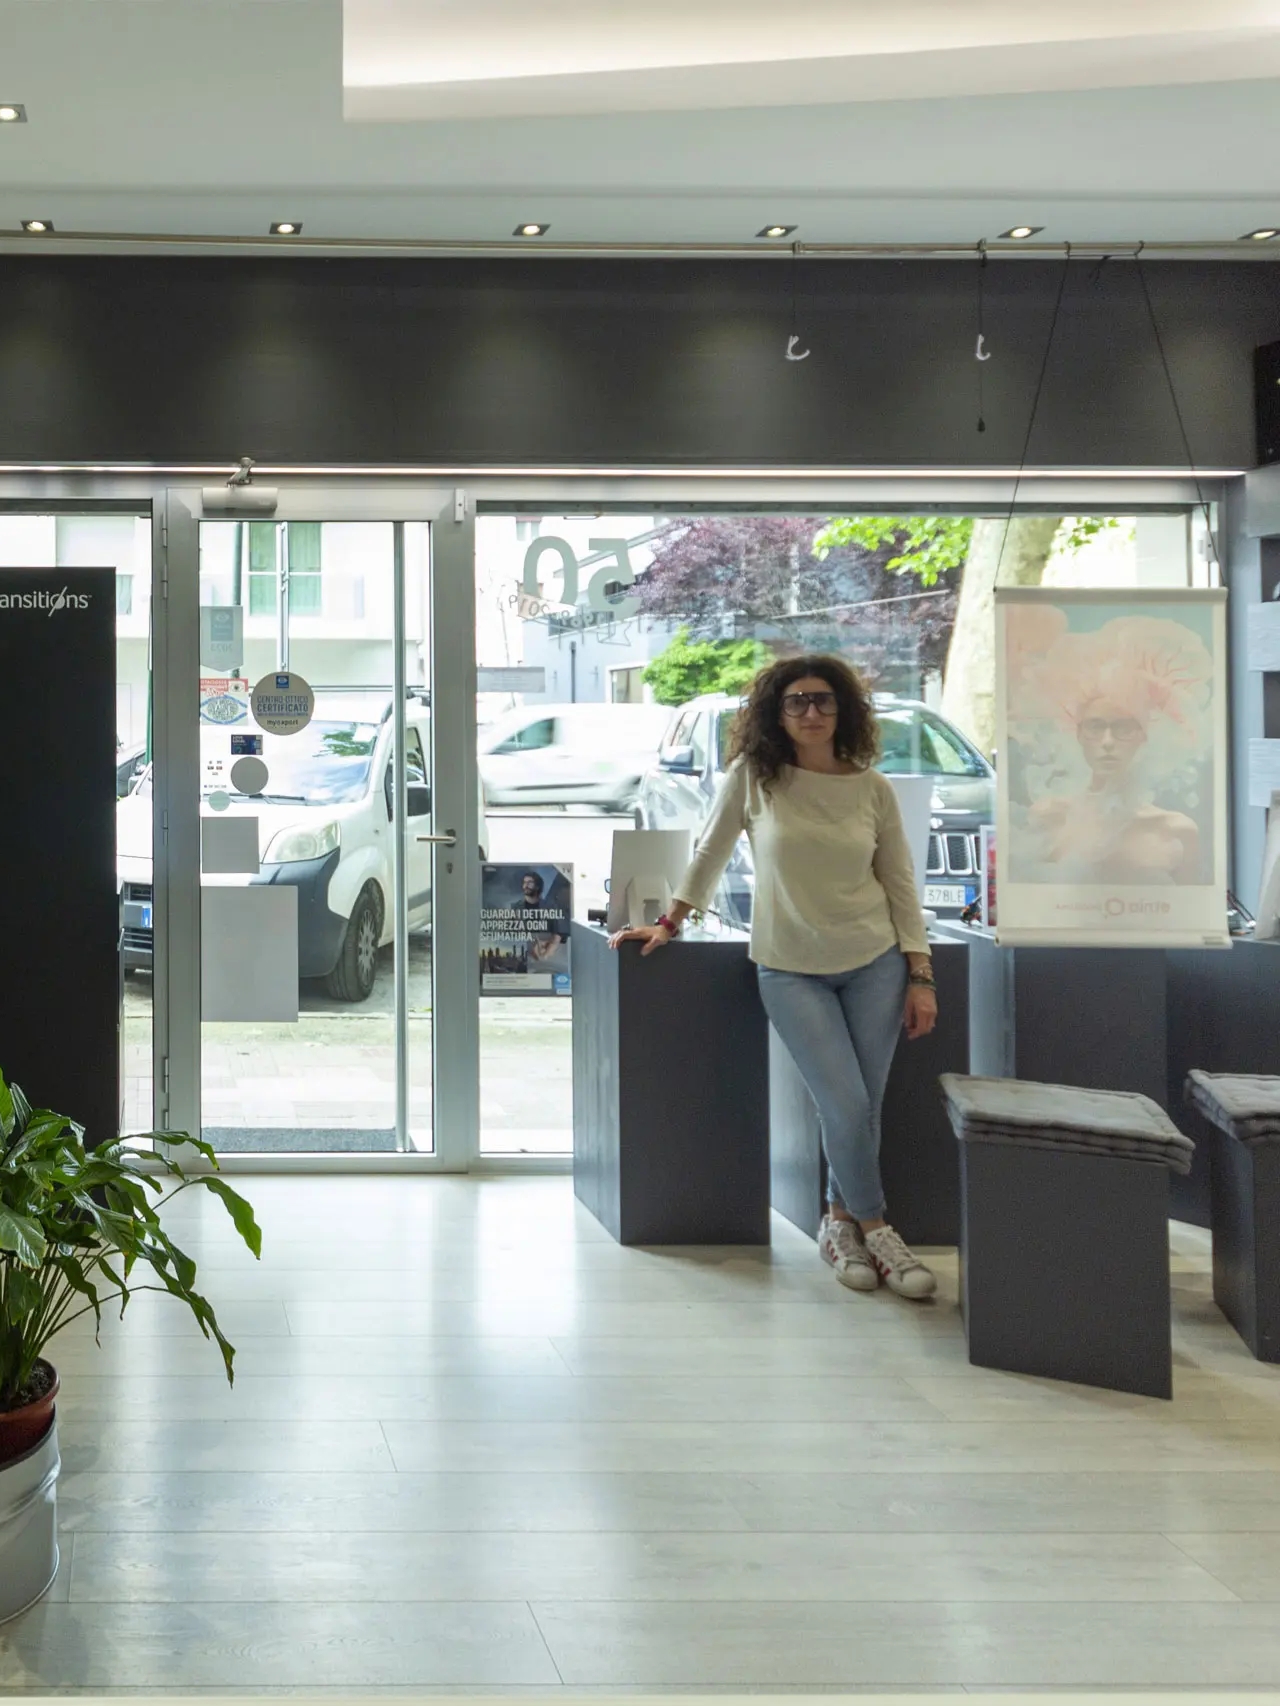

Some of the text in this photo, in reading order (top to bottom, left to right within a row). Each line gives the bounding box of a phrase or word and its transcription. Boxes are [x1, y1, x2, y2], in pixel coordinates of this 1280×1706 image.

[257, 703, 309, 713] CERTIFICATO
[480, 908, 517, 920] GUARDA
[523, 908, 565, 920] DETTAGLI.
[480, 920, 548, 931] APPREZZA OGNI
[480, 931, 536, 942] SFUMATURA.
